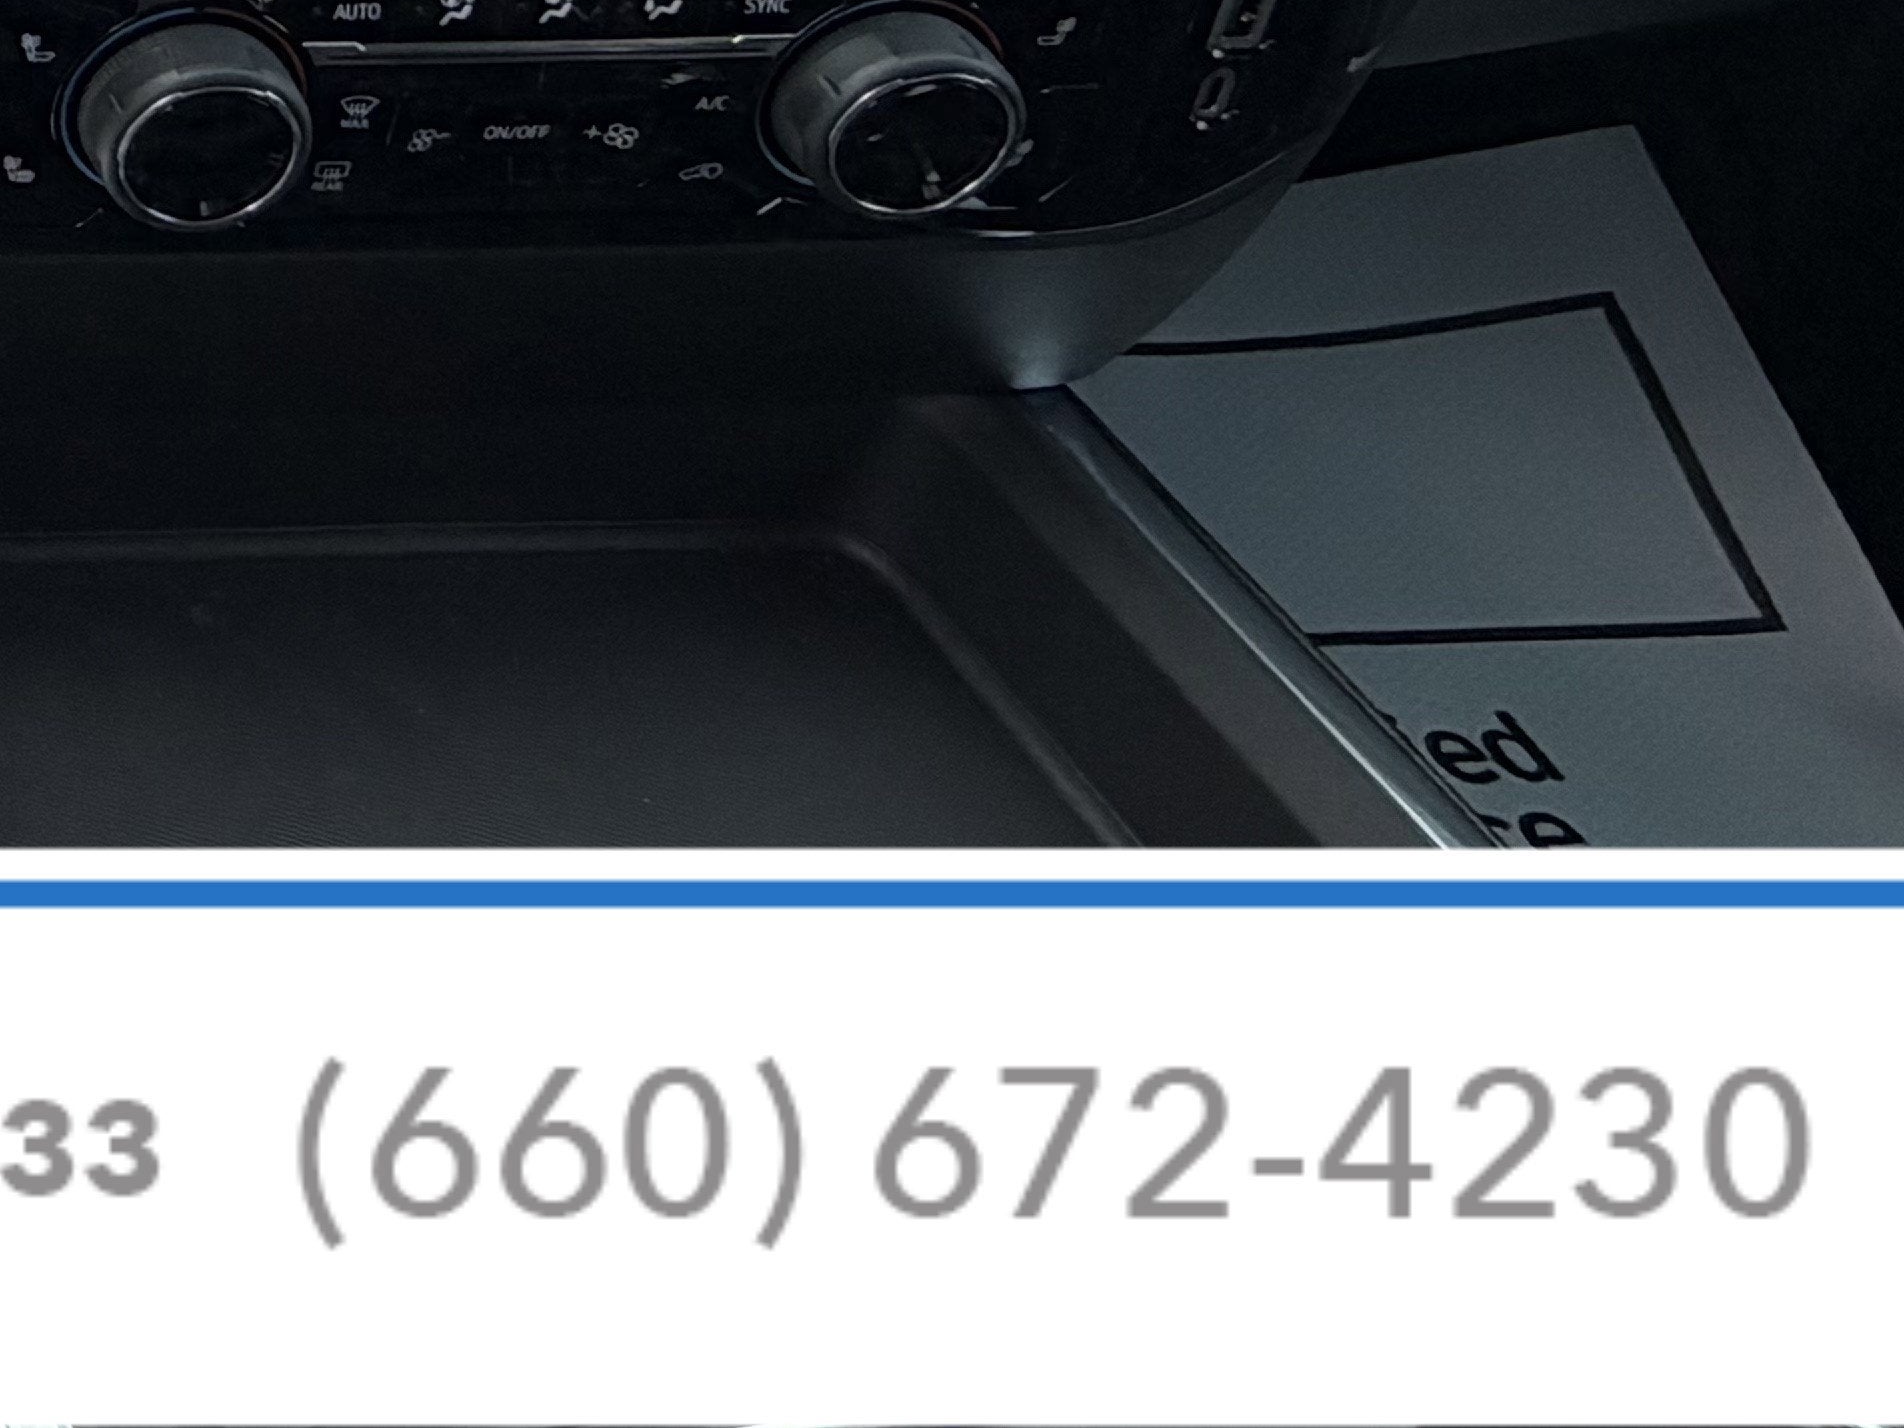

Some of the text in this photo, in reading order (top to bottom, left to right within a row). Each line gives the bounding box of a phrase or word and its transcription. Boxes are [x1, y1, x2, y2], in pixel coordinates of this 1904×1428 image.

[332, 3, 381, 21] AUTO
[695, 95, 730, 112] A/C
[483, 124, 551, 141] ON/OFF
[1382, 709, 1565, 784] ed
